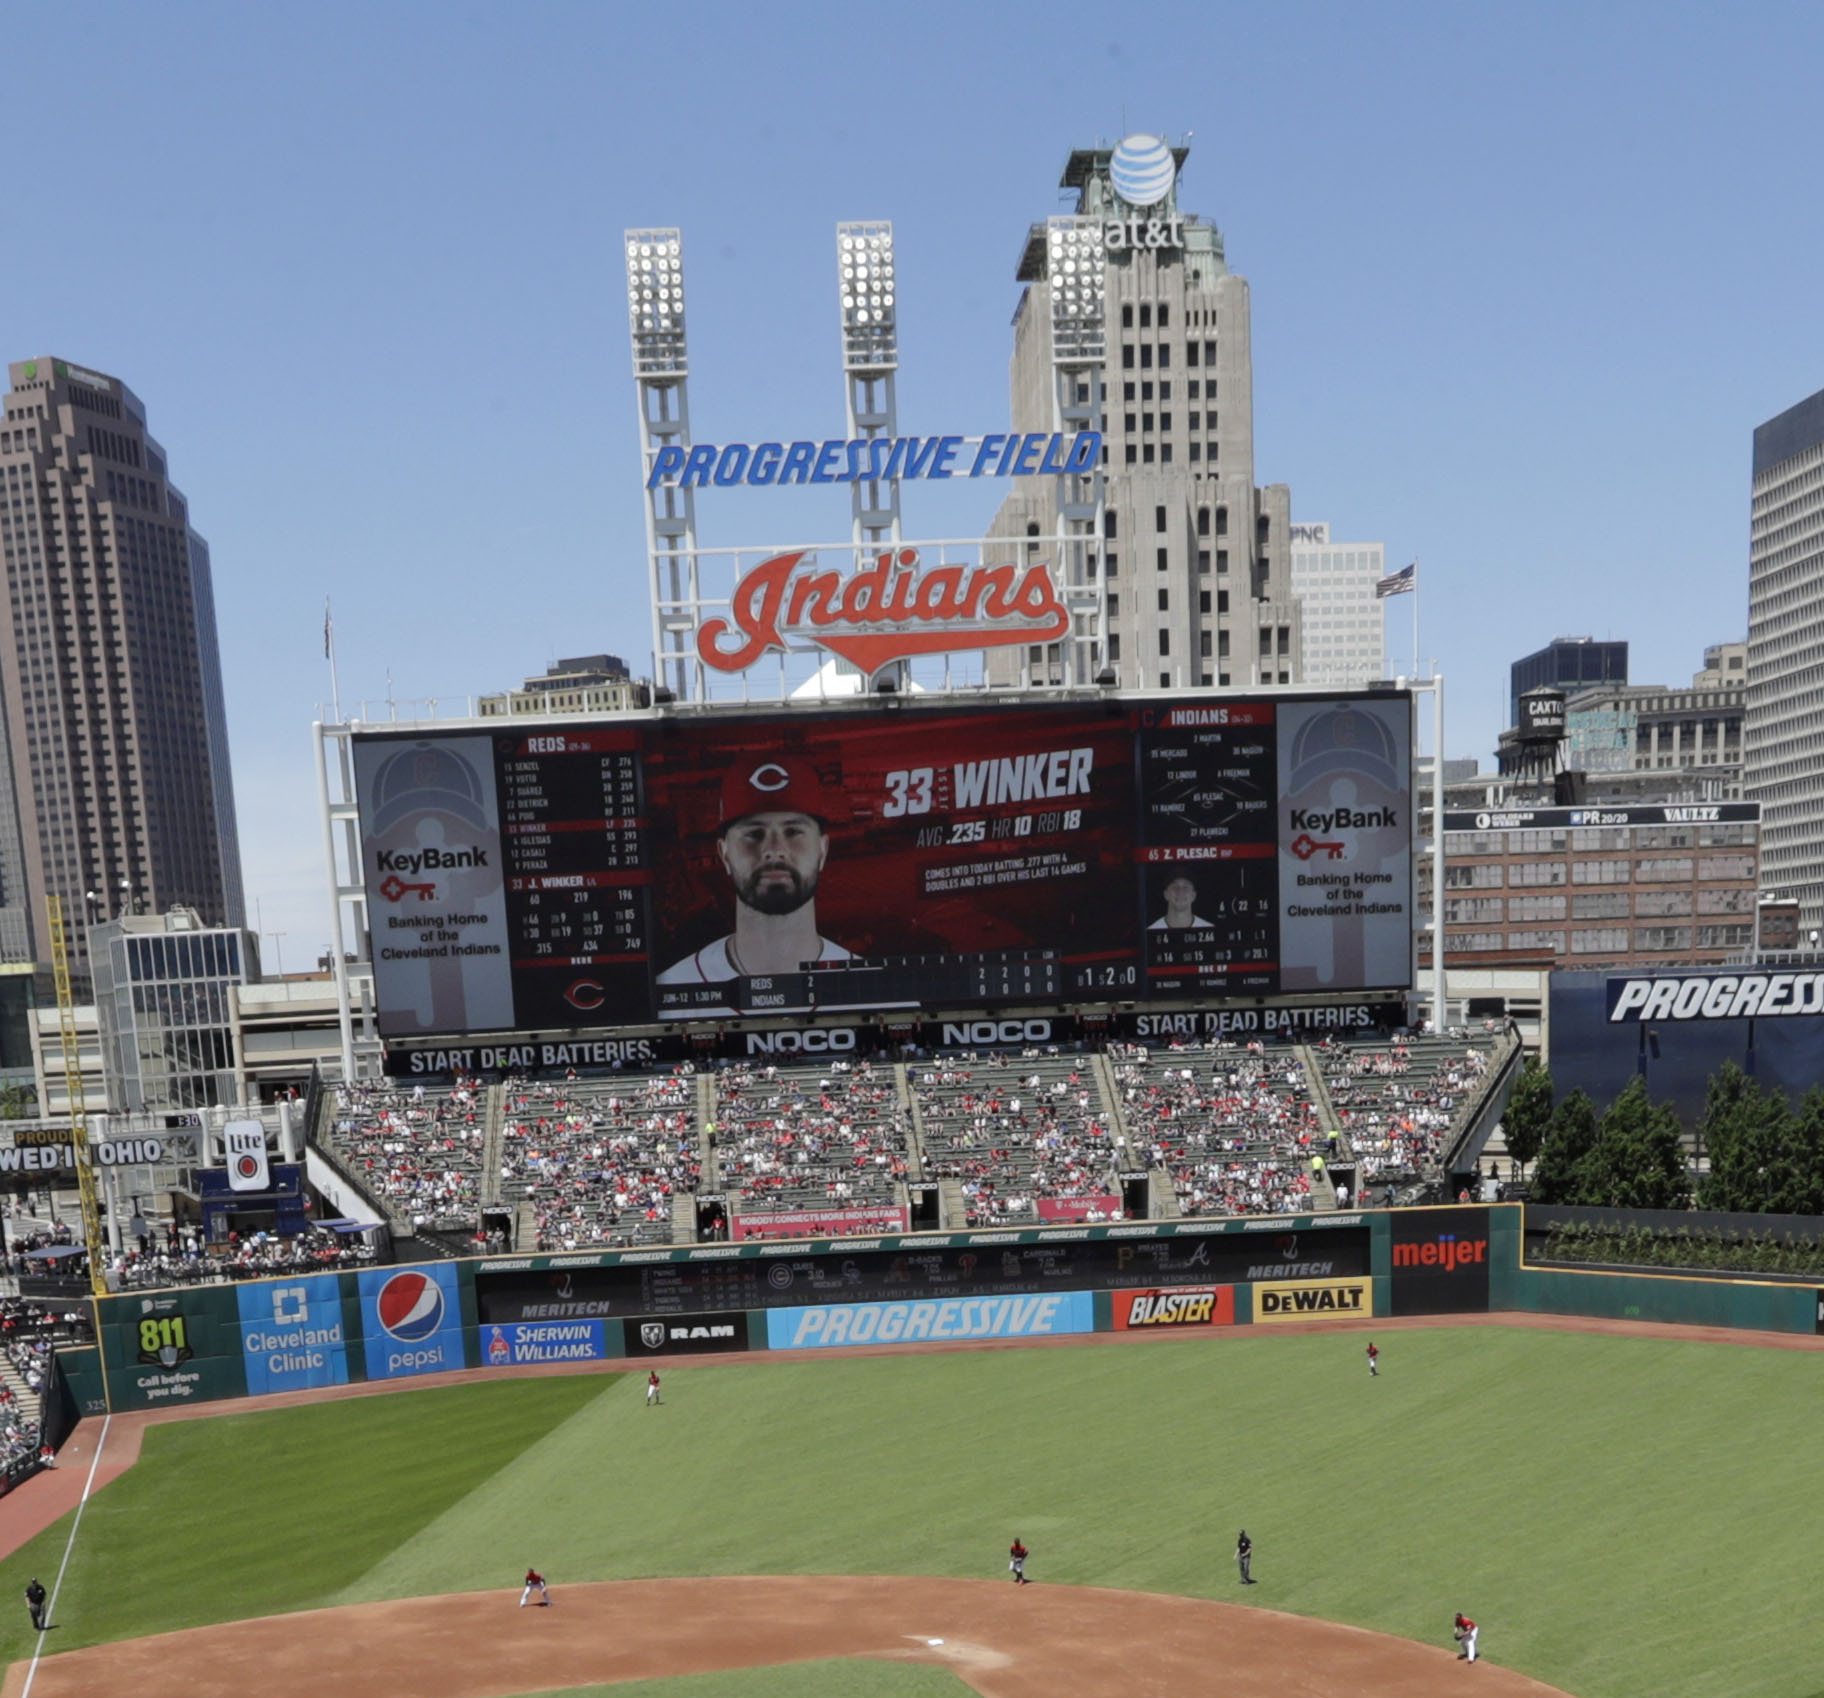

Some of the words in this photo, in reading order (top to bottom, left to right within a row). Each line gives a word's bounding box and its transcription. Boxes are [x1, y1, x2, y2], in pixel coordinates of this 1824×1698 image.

[1104, 216, 1184, 249] at&t
[648, 434, 965, 490] PROGRESSIVE
[972, 430, 1103, 477] FIELD
[694, 546, 1071, 676] Indians
[1171, 709, 1229, 726] INDIANS
[528, 736, 565, 752] REDS
[883, 768, 934, 818] 33
[954, 747, 1094, 809] WINKER
[916, 826, 944, 848] AVG
[946, 820, 987, 845] .235
[992, 818, 1012, 839] HR
[1014, 815, 1032, 836] 10
[1038, 812, 1060, 833] RBI
[1063, 809, 1082, 831] 18
[1290, 807, 1398, 835] KeyBank
[376, 847, 489, 875] KeyBank
[1148, 849, 1160, 861] 65
[1176, 846, 1218, 859] PLESAC
[926, 867, 951, 880] COMES
[952, 865, 969, 878] INTO
[970, 863, 992, 875] TODAY
[995, 859, 1025, 872] BATTING
[1043, 854, 1060, 865] WITH
[926, 879, 959, 892] DOUBLES
[960, 876, 976, 888] AND
[983, 874, 996, 885] RBI
[997, 871, 1016, 883] OVER
[1017, 869, 1030, 881] HIS
[1031, 867, 1050, 879] LAST
[1061, 862, 1087, 875] GAMES
[1297, 873, 1352, 888] Banking
[1353, 871, 1393, 885] Home
[511, 879, 523, 892] 33
[541, 874, 585, 889] WINKER
[1326, 887, 1340, 900] of
[1342, 886, 1364, 900] the
[1287, 903, 1354, 918] Cleveland
[1355, 902, 1403, 916] Indians
[943, 1019, 1051, 1045] NOCO
[1136, 1012, 1199, 1036] START
[1204, 1010, 1259, 1034] DEAD
[746, 1028, 855, 1055] NOCO
[98, 1138, 162, 1166] OHIO
[228, 1131, 262, 1154] Lite
[738, 1213, 776, 1226] NOBODY
[776, 1211, 820, 1224] CONNECTS
[821, 1211, 843, 1222] MORE
[844, 1209, 878, 1221] INDIANS
[879, 1208, 901, 1219] FANS
[1392, 1234, 1487, 1271] meijer
[1247, 1262, 1333, 1279] MERITECH
[522, 1301, 610, 1318] MERITECH
[1262, 1287, 1363, 1312] DeWALT
[139, 1316, 185, 1352] 811
[515, 1325, 592, 1344] SHERWIN
[670, 1325, 735, 1340] RAM
[792, 1297, 1063, 1346] PROGRESSIVE
[245, 1324, 341, 1354] Cleveland
[268, 1350, 324, 1373] Clinic
[388, 1345, 445, 1373] pepsi
